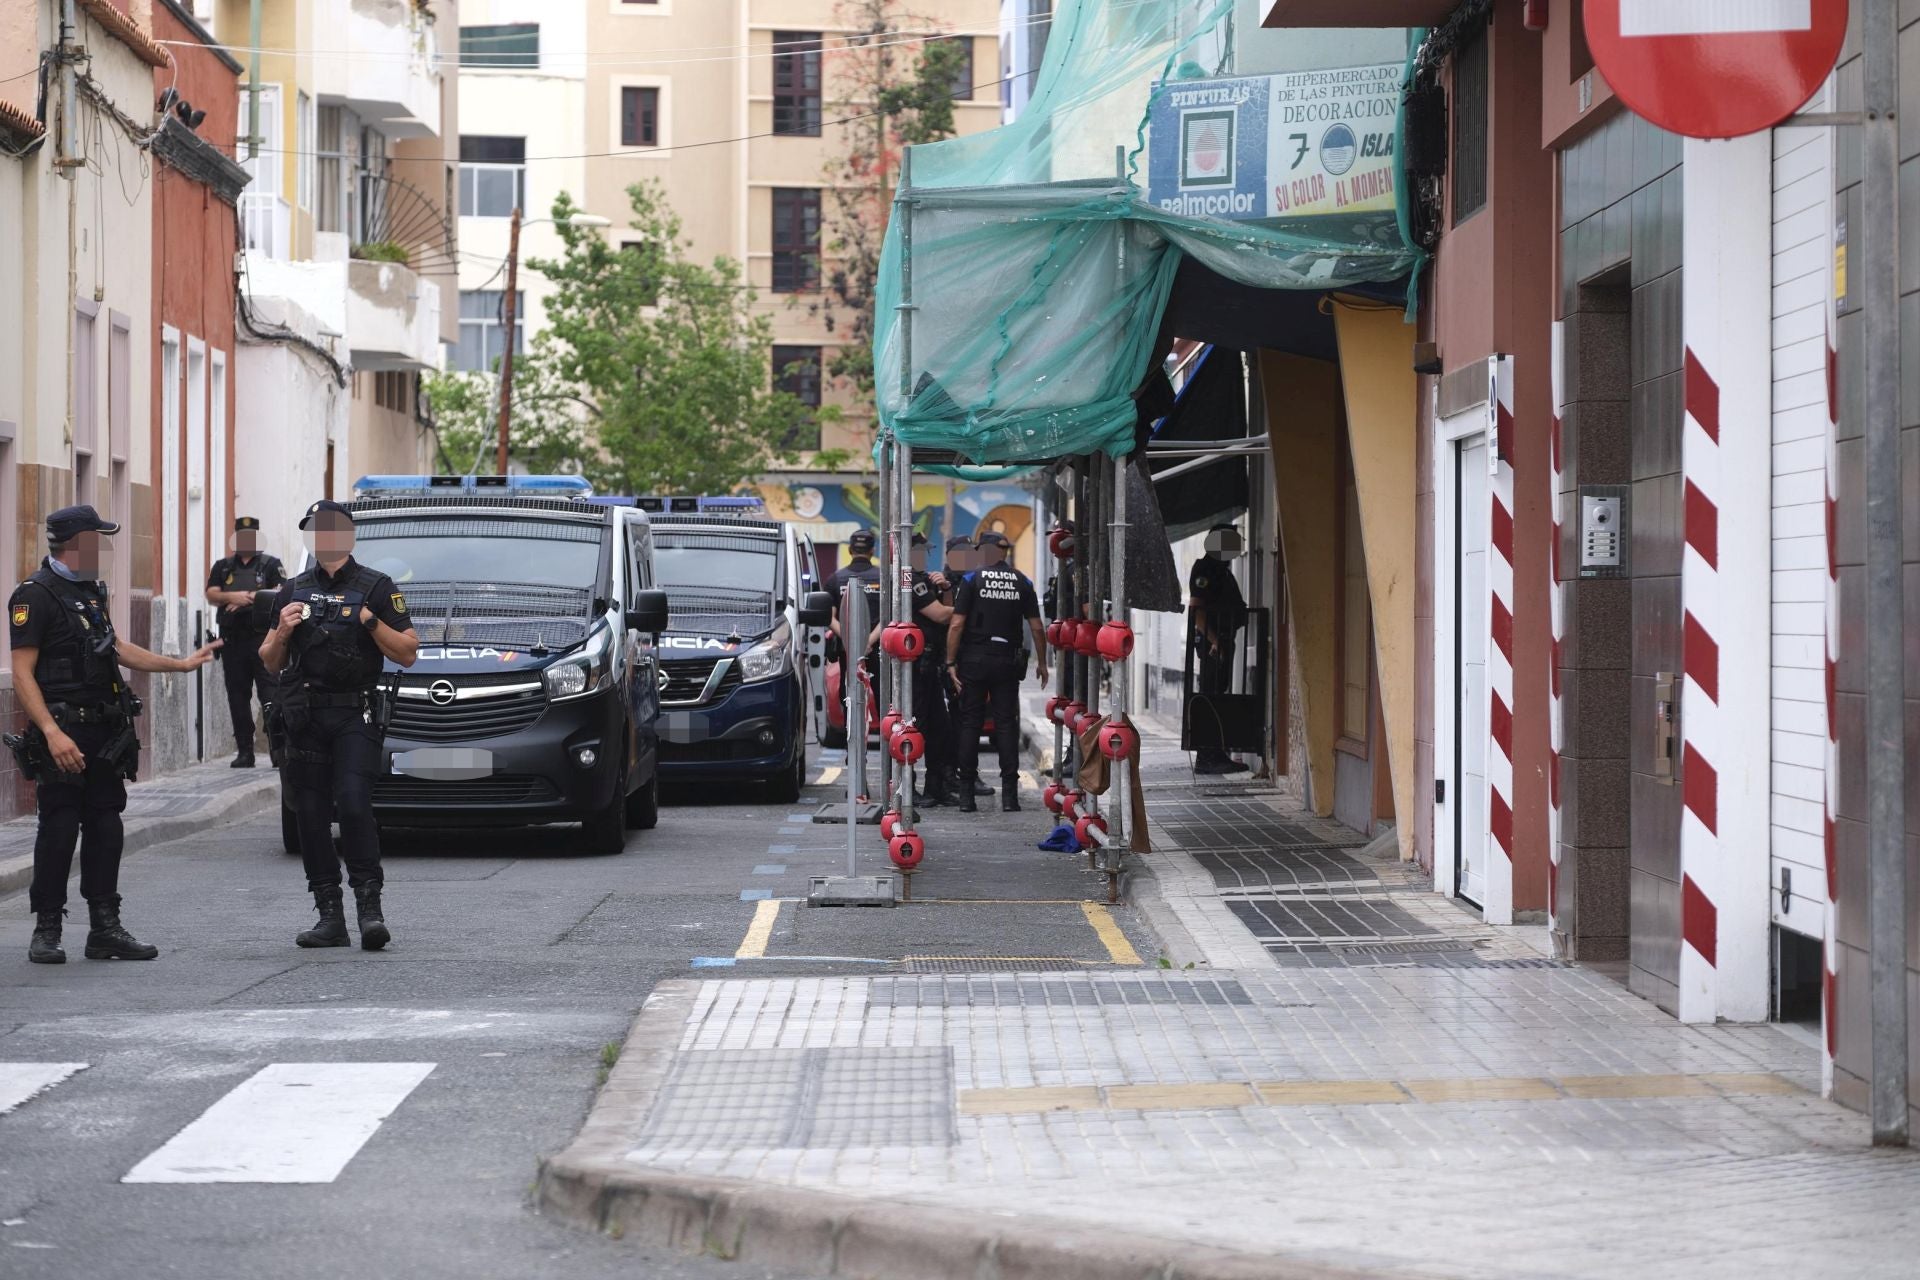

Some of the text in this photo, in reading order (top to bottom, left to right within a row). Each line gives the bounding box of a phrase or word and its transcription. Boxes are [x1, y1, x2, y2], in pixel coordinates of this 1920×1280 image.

[1286, 66, 1398, 87] HIPERMERCADO
[1170, 86, 1251, 107] PINTURAS
[1278, 81, 1402, 102] DE LAS PINTURAS
[1283, 97, 1397, 123] DECORACION
[1288, 132, 1395, 170] 7 ISLA
[1275, 183, 1290, 212] SU
[1292, 173, 1326, 207] COLOR
[1335, 180, 1349, 207] AL
[1160, 190, 1256, 217] palmcolor
[981, 570, 1018, 581] POLICIA
[985, 580, 1016, 590] LOCAL
[980, 588, 1020, 600] CANARIA
[659, 636, 725, 649] ICIA
[416, 647, 503, 660] LICIA
